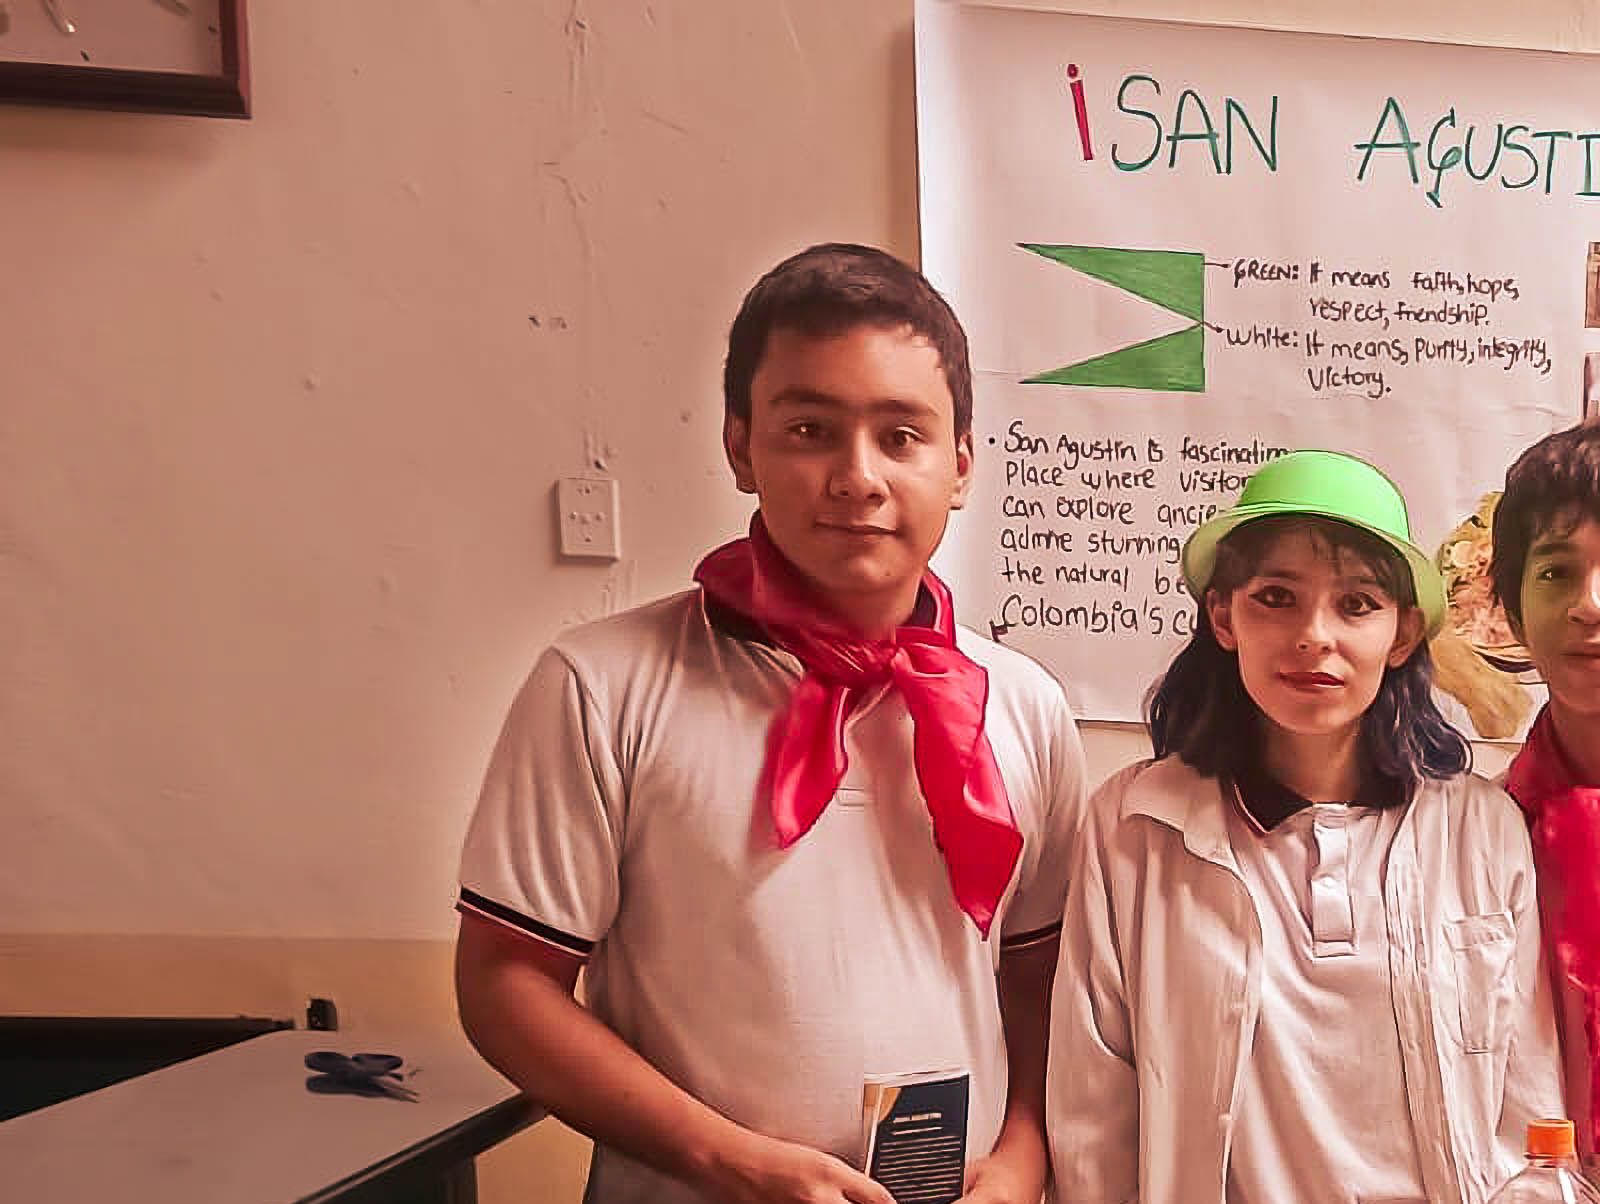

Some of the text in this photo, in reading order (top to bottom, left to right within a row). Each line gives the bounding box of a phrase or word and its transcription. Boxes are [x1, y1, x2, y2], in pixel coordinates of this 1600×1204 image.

[1067, 62, 1279, 174] ¡SAN
[1234, 259, 1299, 288] GREEN:
[1332, 270, 1391, 289] means
[1005, 421, 1048, 453] San
[1080, 469, 1155, 491] where
[1001, 556, 1045, 584] the
[1056, 562, 1129, 592] natural
